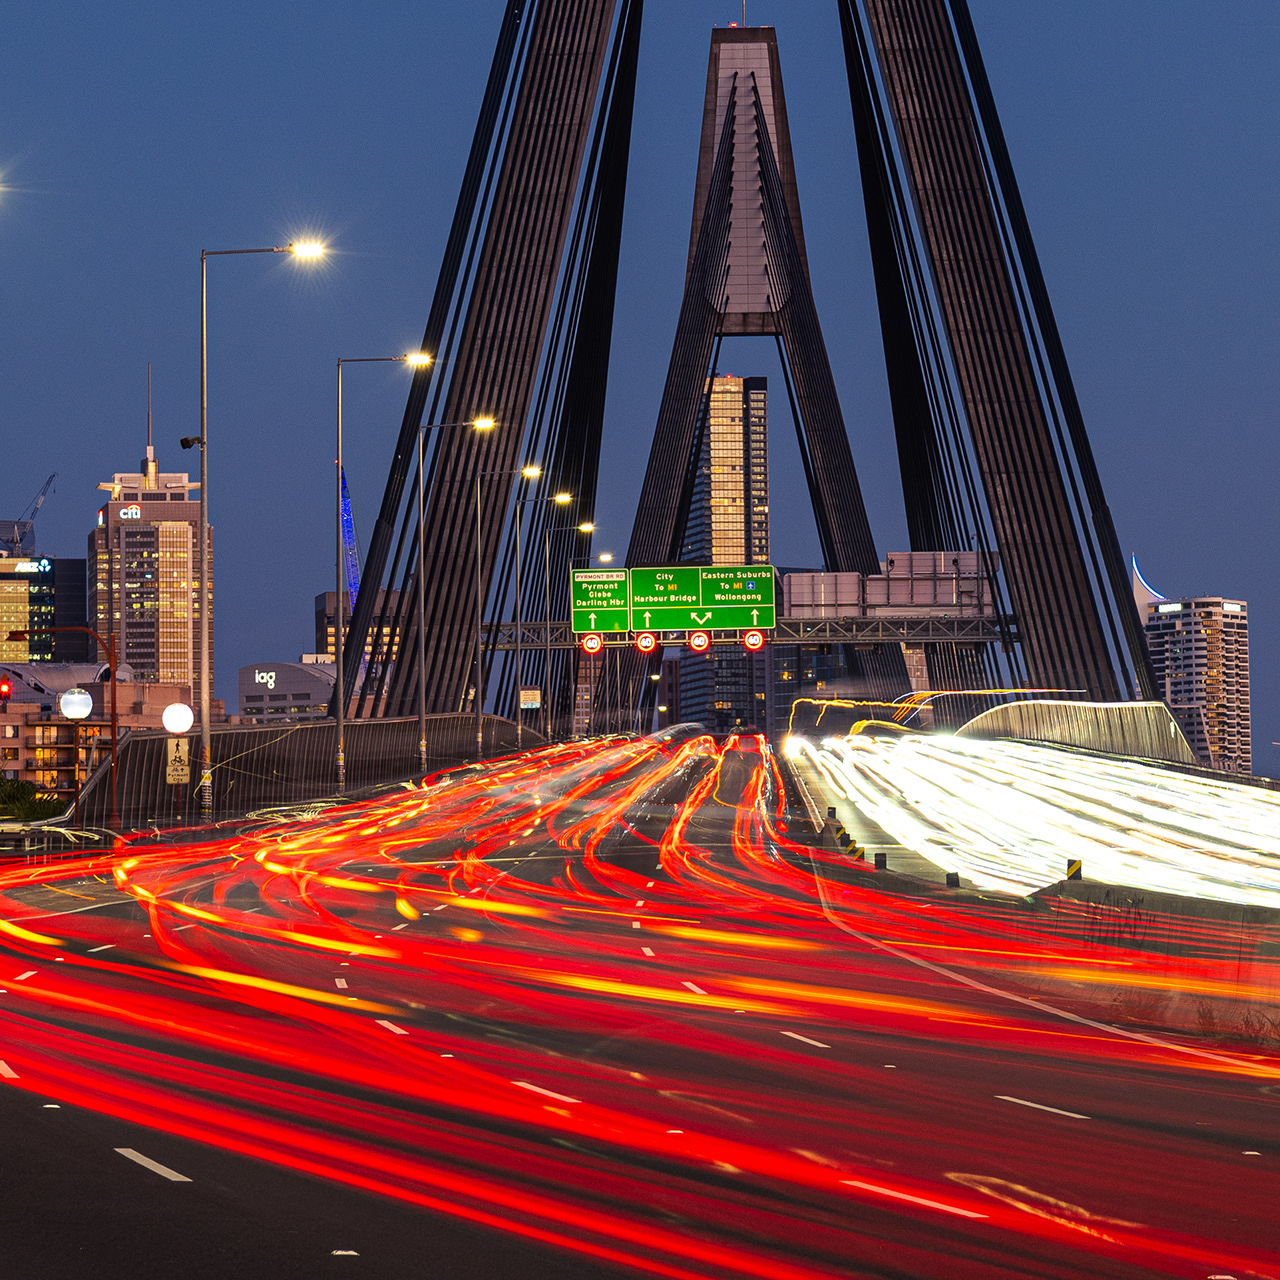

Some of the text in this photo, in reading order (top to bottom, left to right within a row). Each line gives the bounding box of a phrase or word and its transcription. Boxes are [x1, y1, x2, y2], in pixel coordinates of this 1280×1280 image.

[119, 505, 141, 519] citi
[14, 562, 39, 572] ANZ
[670, 594, 696, 602] Bridge
[714, 593, 762, 601] Wollongong
[586, 638, 598, 648] 60
[640, 637, 652, 647] 60
[693, 636, 705, 646] 60
[748, 635, 760, 645] 60
[255, 670, 276, 689] iag
